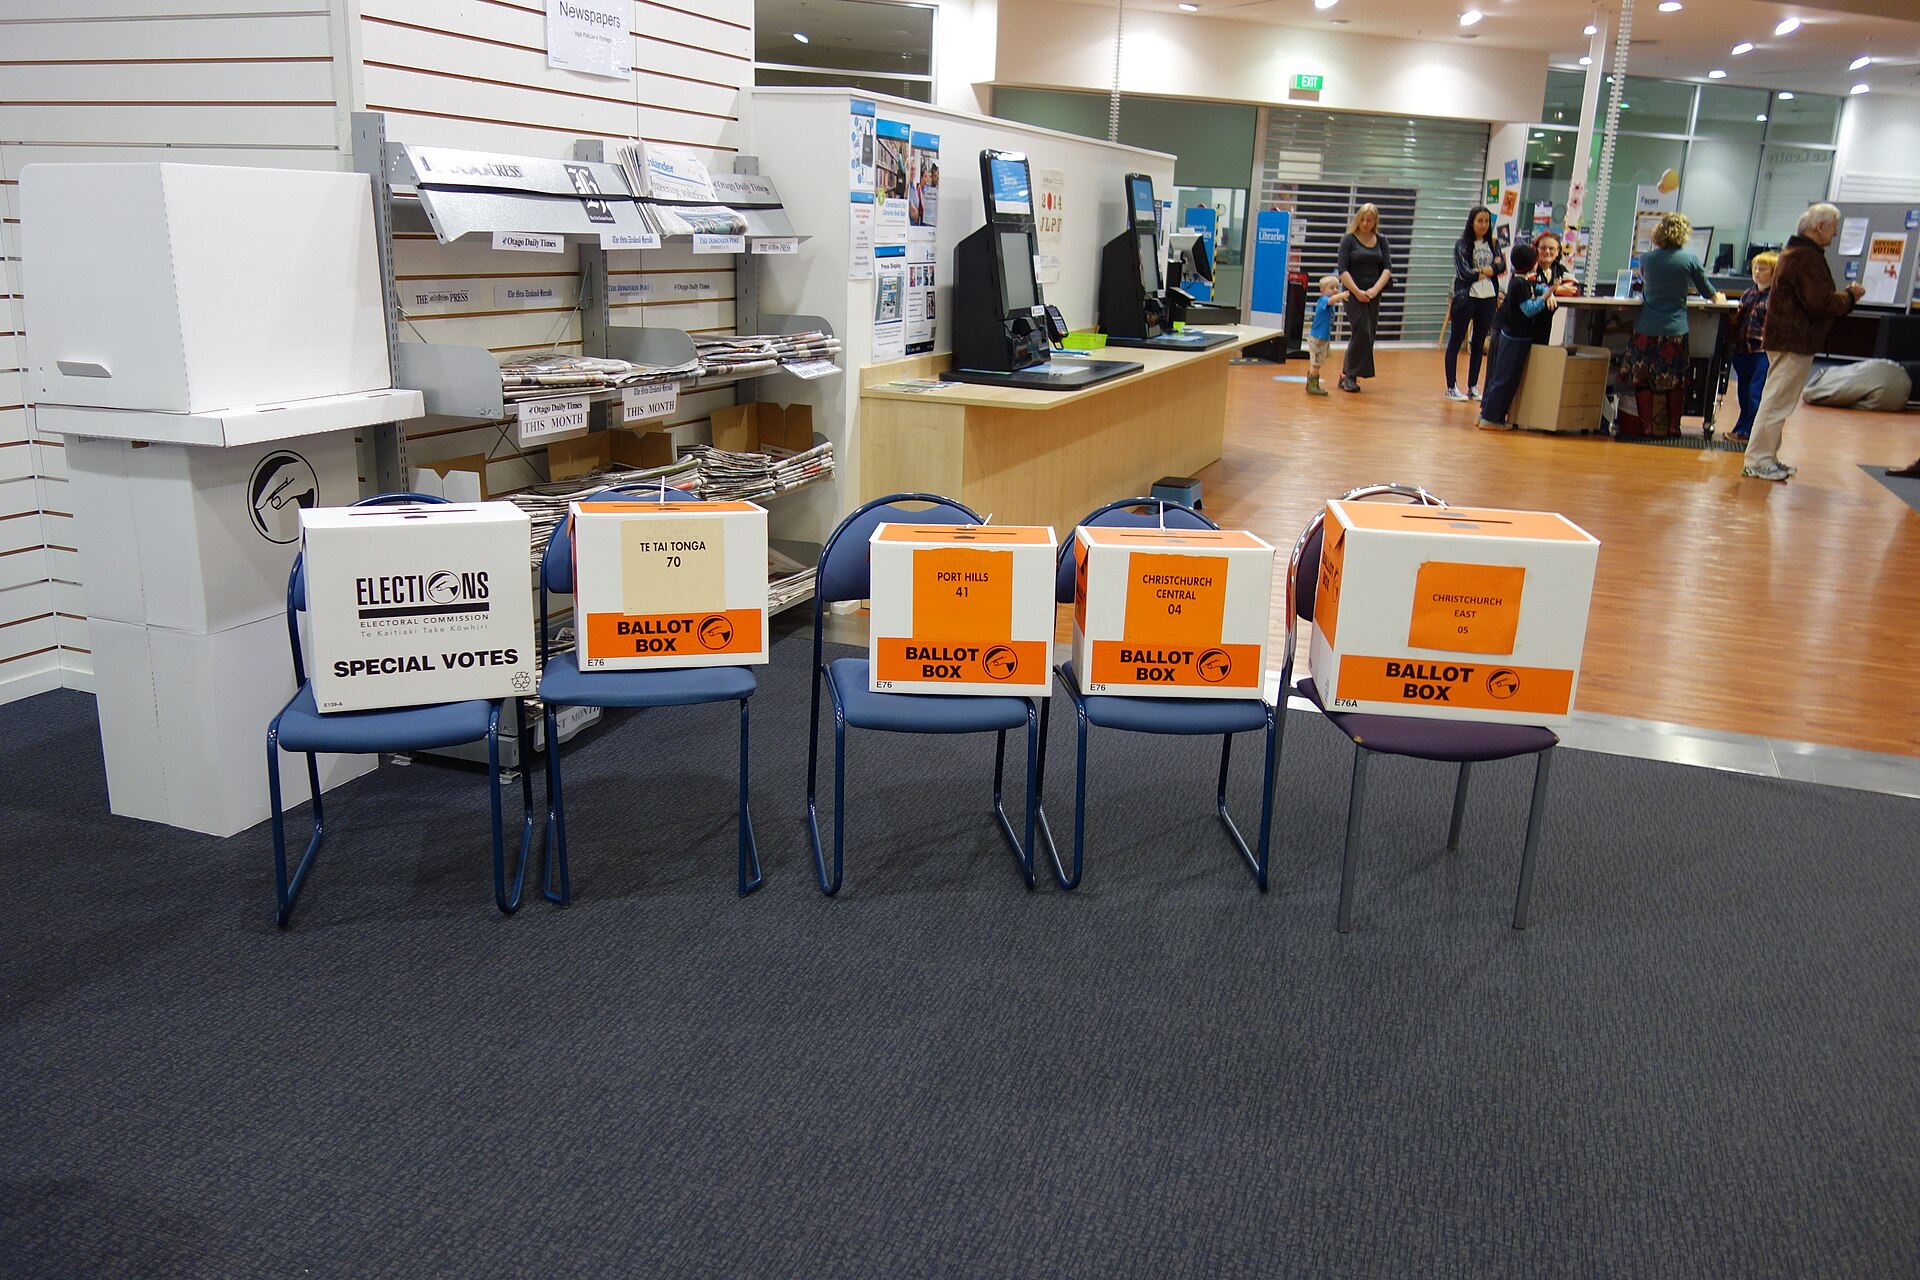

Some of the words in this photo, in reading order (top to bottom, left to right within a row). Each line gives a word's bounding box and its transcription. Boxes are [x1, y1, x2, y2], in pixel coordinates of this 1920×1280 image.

[559, 1, 621, 28] Newspapers
[1301, 76, 1318, 88] EXIT
[1040, 216, 1062, 233] JLPT
[508, 237, 524, 248] Otago
[525, 238, 539, 248] Daily
[540, 239, 556, 248] Times
[1258, 232, 1285, 241] Libraries
[1873, 247, 1900, 255] VOTING
[415, 294, 429, 304] THE
[449, 293, 469, 302] PRESS
[533, 405, 550, 415] Otago
[551, 403, 566, 413] Daily
[566, 402, 583, 410] Times
[626, 405, 645, 418] THIS
[649, 400, 675, 414] MONTH
[524, 419, 545, 434] THIS
[551, 413, 583, 429] MONTH
[640, 542, 650, 552] TE
[653, 542, 668, 552] TAI
[670, 541, 706, 551] TONGA
[666, 556, 681, 567] 70
[937, 572, 961, 581] PORT
[964, 572, 989, 582] HILLS
[1142, 574, 1212, 587] CHRISTCHURCH
[356, 570, 489, 605] ELECTIONS
[955, 587, 968, 597] 41
[1156, 589, 1196, 600] CENTRAL
[1432, 594, 1502, 606] CHRISTCHURCH
[1167, 604, 1182, 615] 04
[1454, 609, 1477, 618] EAST
[360, 618, 419, 628] ELECTORAL
[423, 614, 489, 624] COMMISSION
[617, 619, 694, 635] BALLOT
[377, 628, 417, 637] Kaitiaki
[423, 626, 445, 634] Take
[1457, 626, 1468, 634] 05
[635, 638, 677, 653] BOX
[905, 647, 979, 661] BALLOT
[1120, 650, 1194, 665] BALLOT
[333, 655, 435, 678] SPECIAL
[441, 648, 519, 670] VOTES
[587, 659, 605, 667] E76
[922, 664, 962, 679] BOX
[1136, 667, 1176, 682] BOX
[1385, 662, 1474, 683] BALLOT
[876, 681, 893, 689] E76
[1090, 683, 1106, 691] E76
[1403, 683, 1452, 701] BOX
[1334, 698, 1358, 708] E76A
